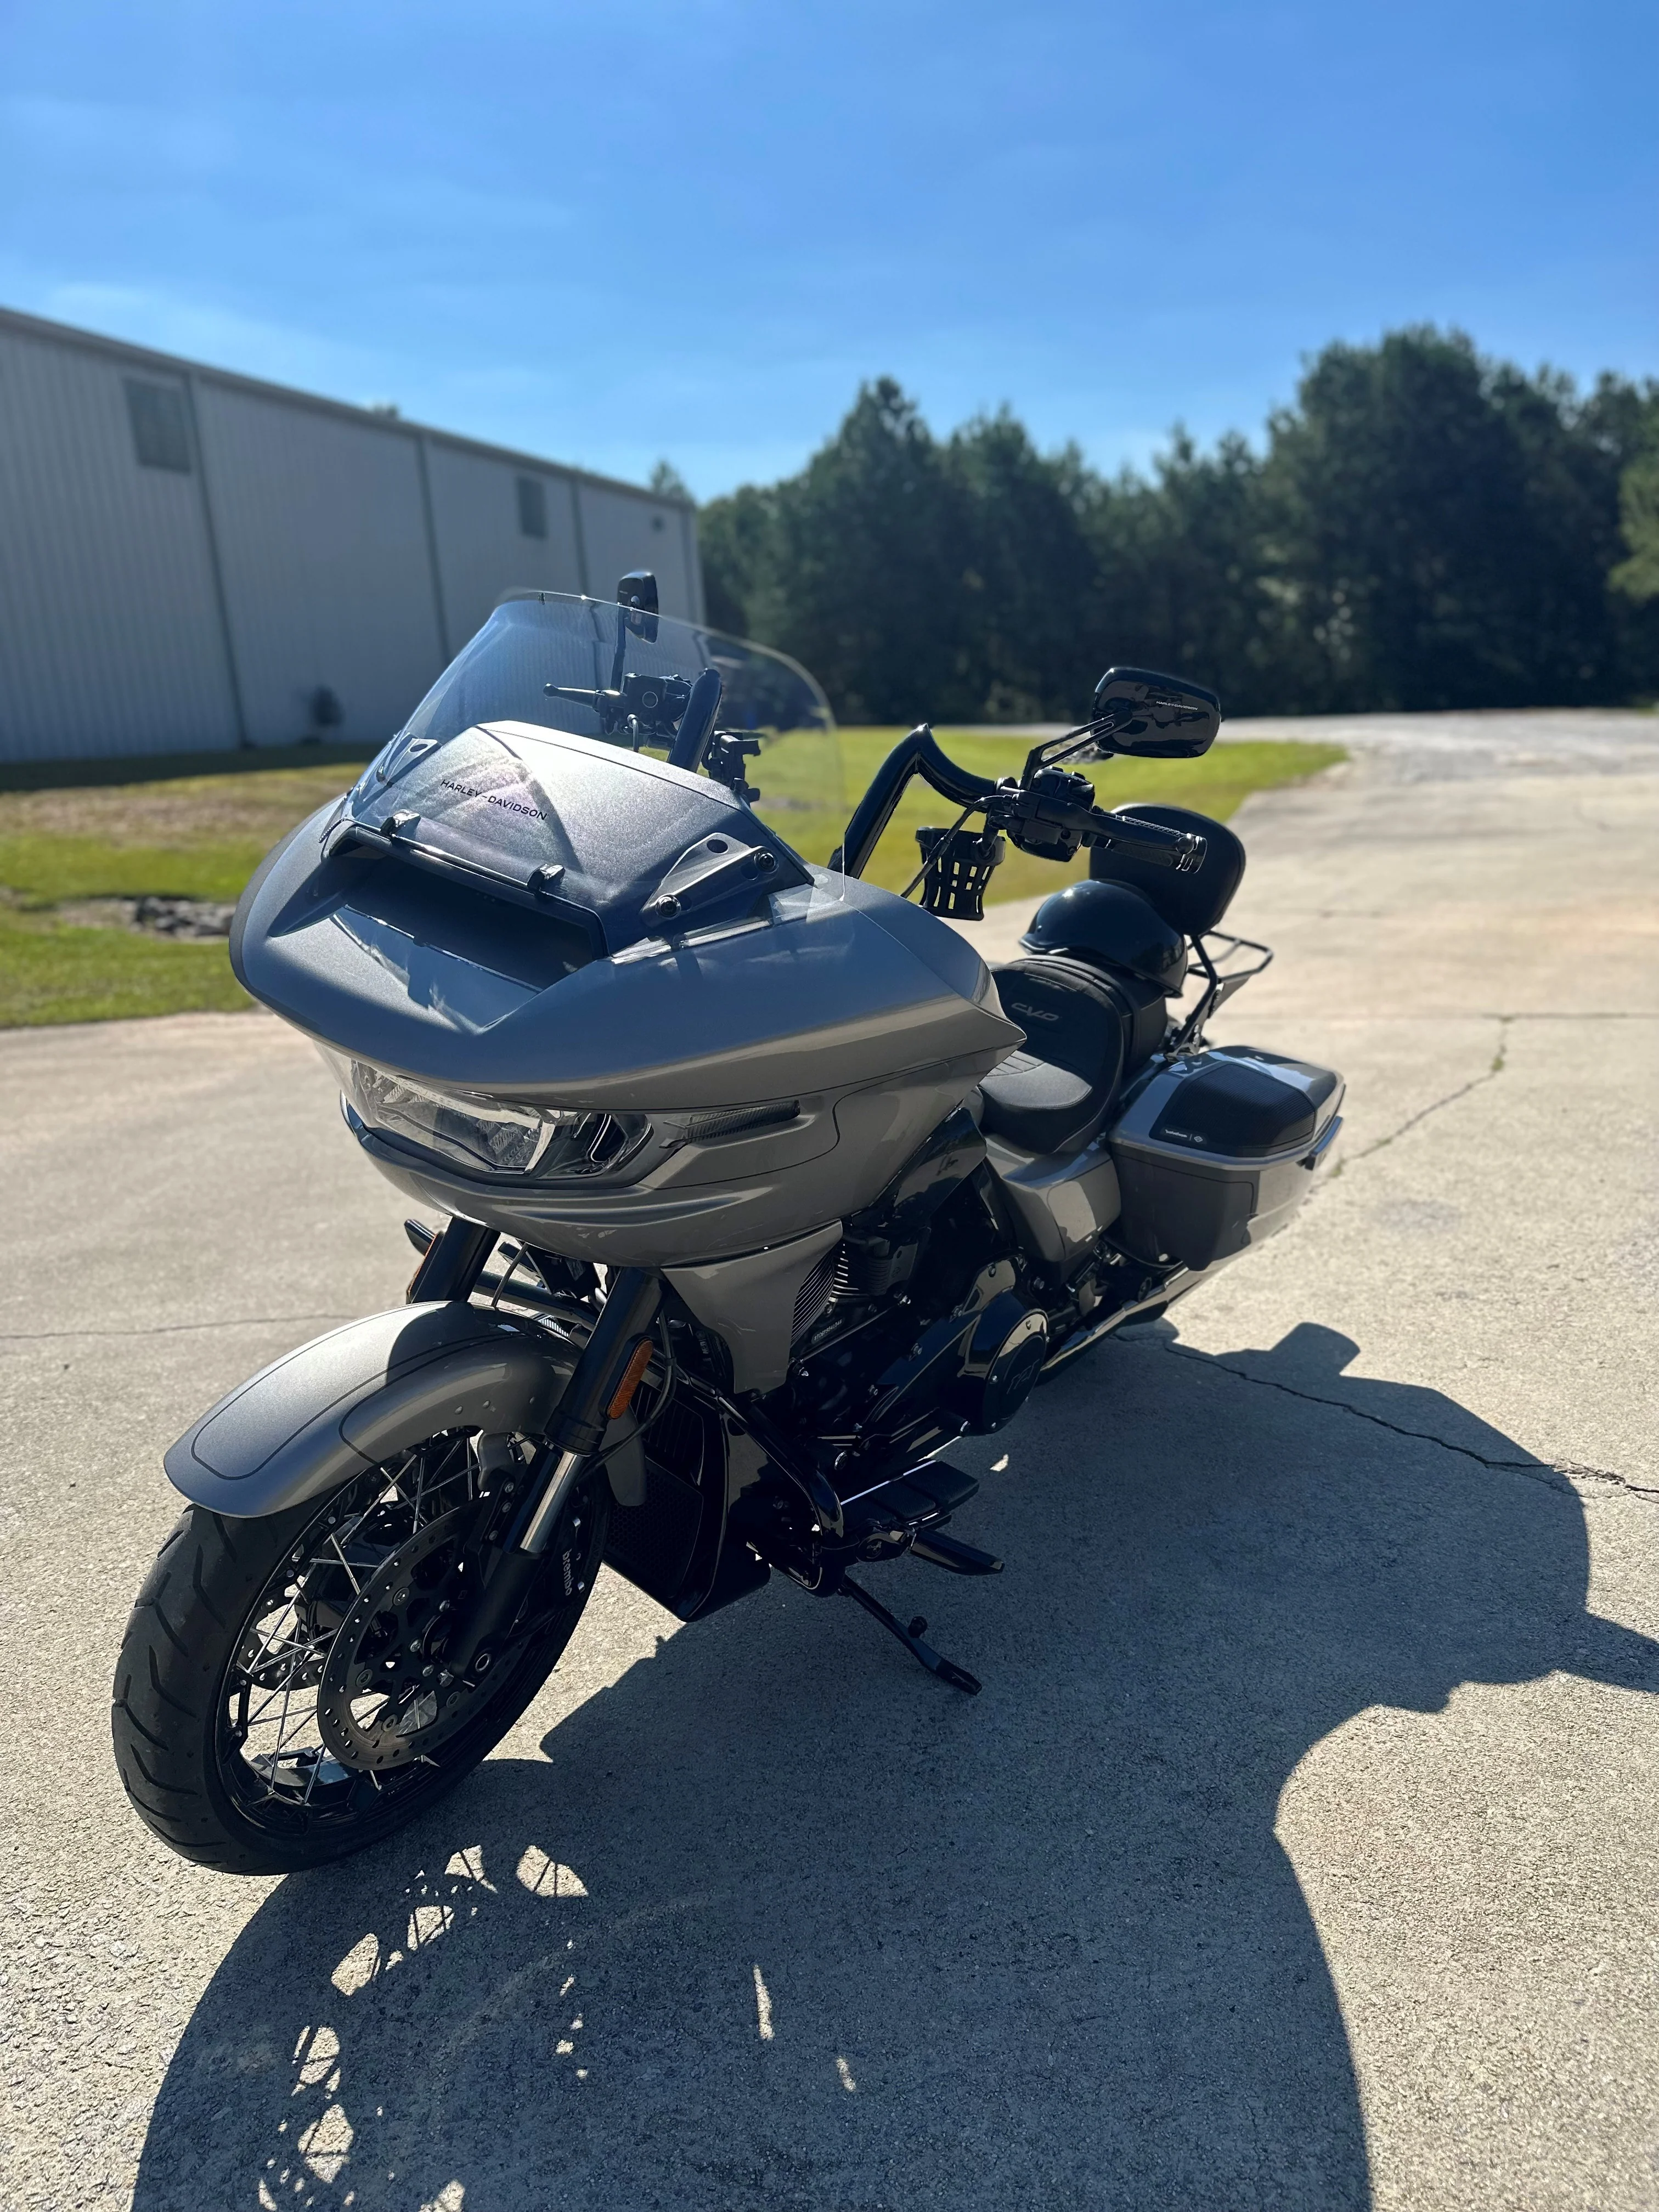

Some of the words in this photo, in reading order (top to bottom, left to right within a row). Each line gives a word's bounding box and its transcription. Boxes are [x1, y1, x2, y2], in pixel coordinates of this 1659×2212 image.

[441, 779, 548, 821] HARLEY-DAVIDSON
[1011, 1002, 1059, 1022] CVO
[562, 1548, 574, 1596] brembo
